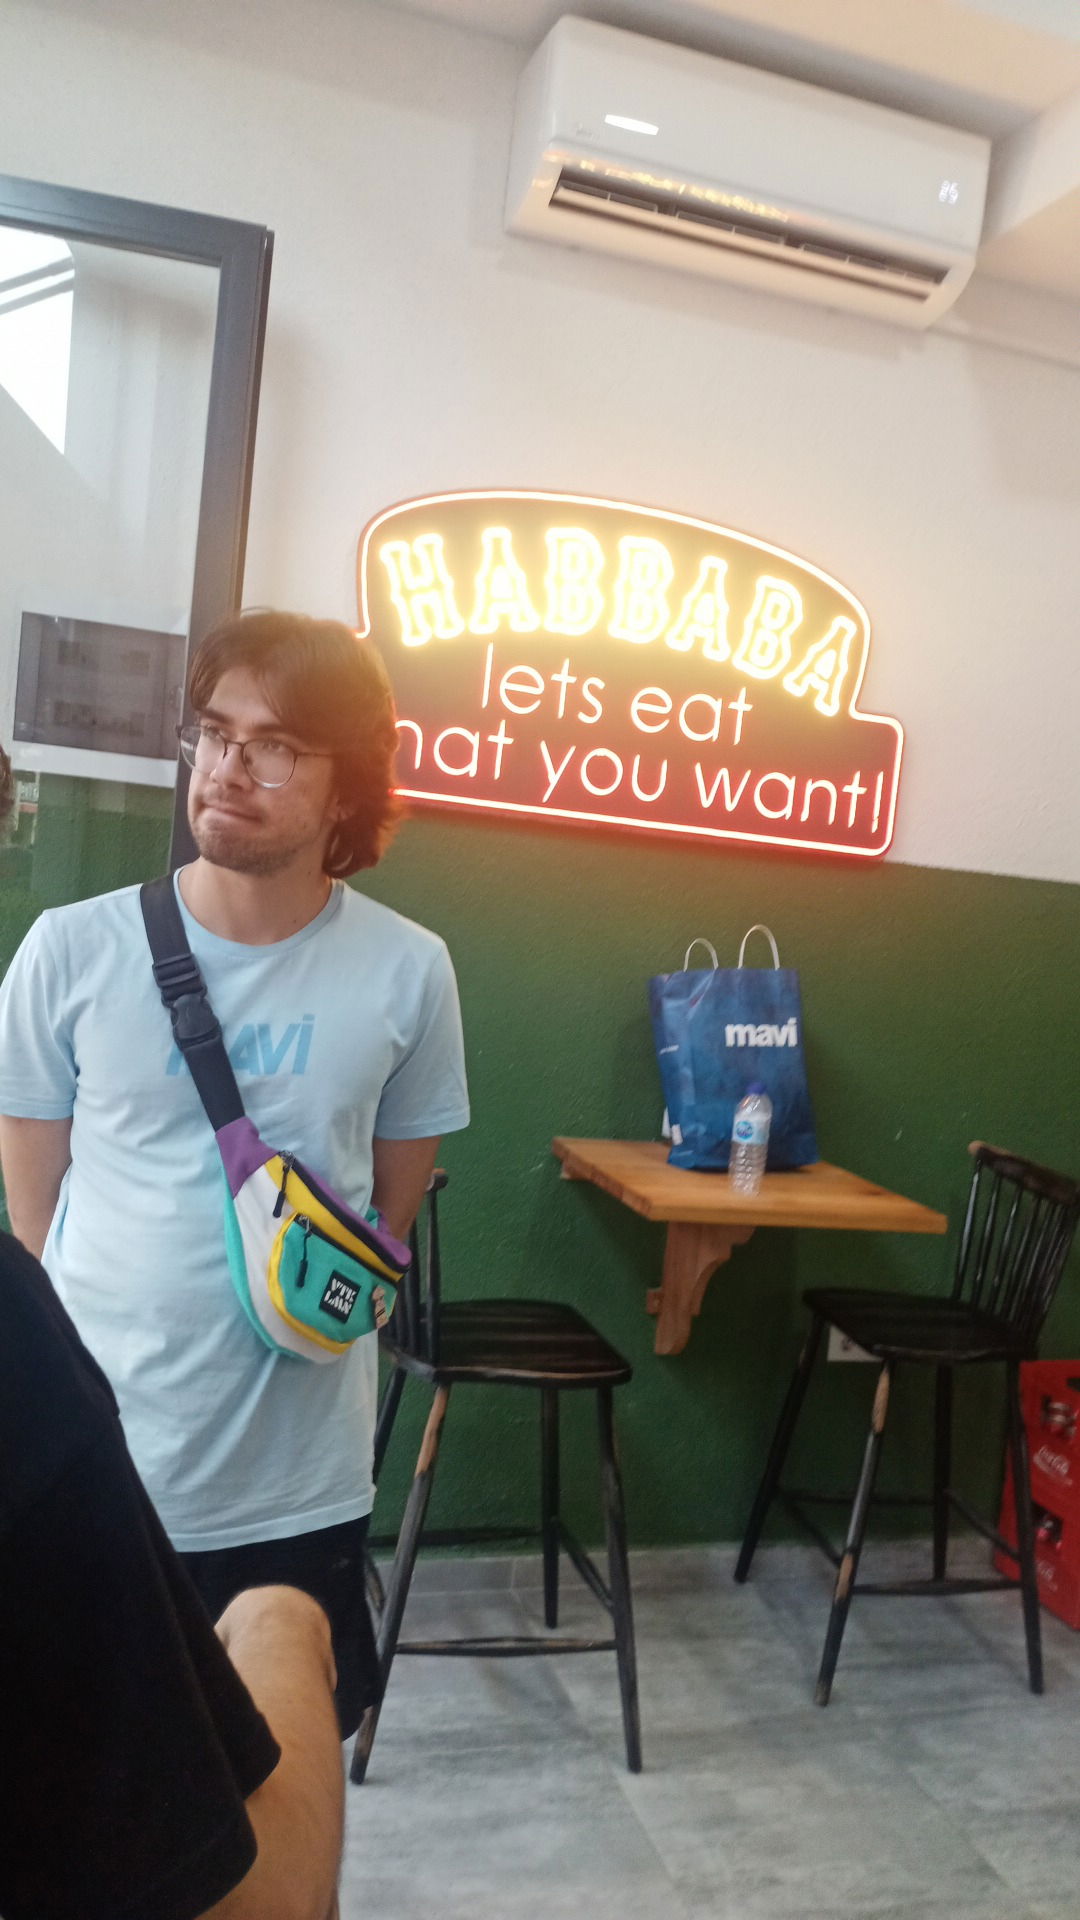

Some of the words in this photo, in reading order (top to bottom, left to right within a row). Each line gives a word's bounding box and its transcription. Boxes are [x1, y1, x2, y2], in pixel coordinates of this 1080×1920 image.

[379, 525, 859, 717] HABBABA
[480, 643, 605, 724] lets
[629, 687, 753, 745] eat
[540, 740, 668, 803] you
[725, 1017, 798, 1047] mavi
